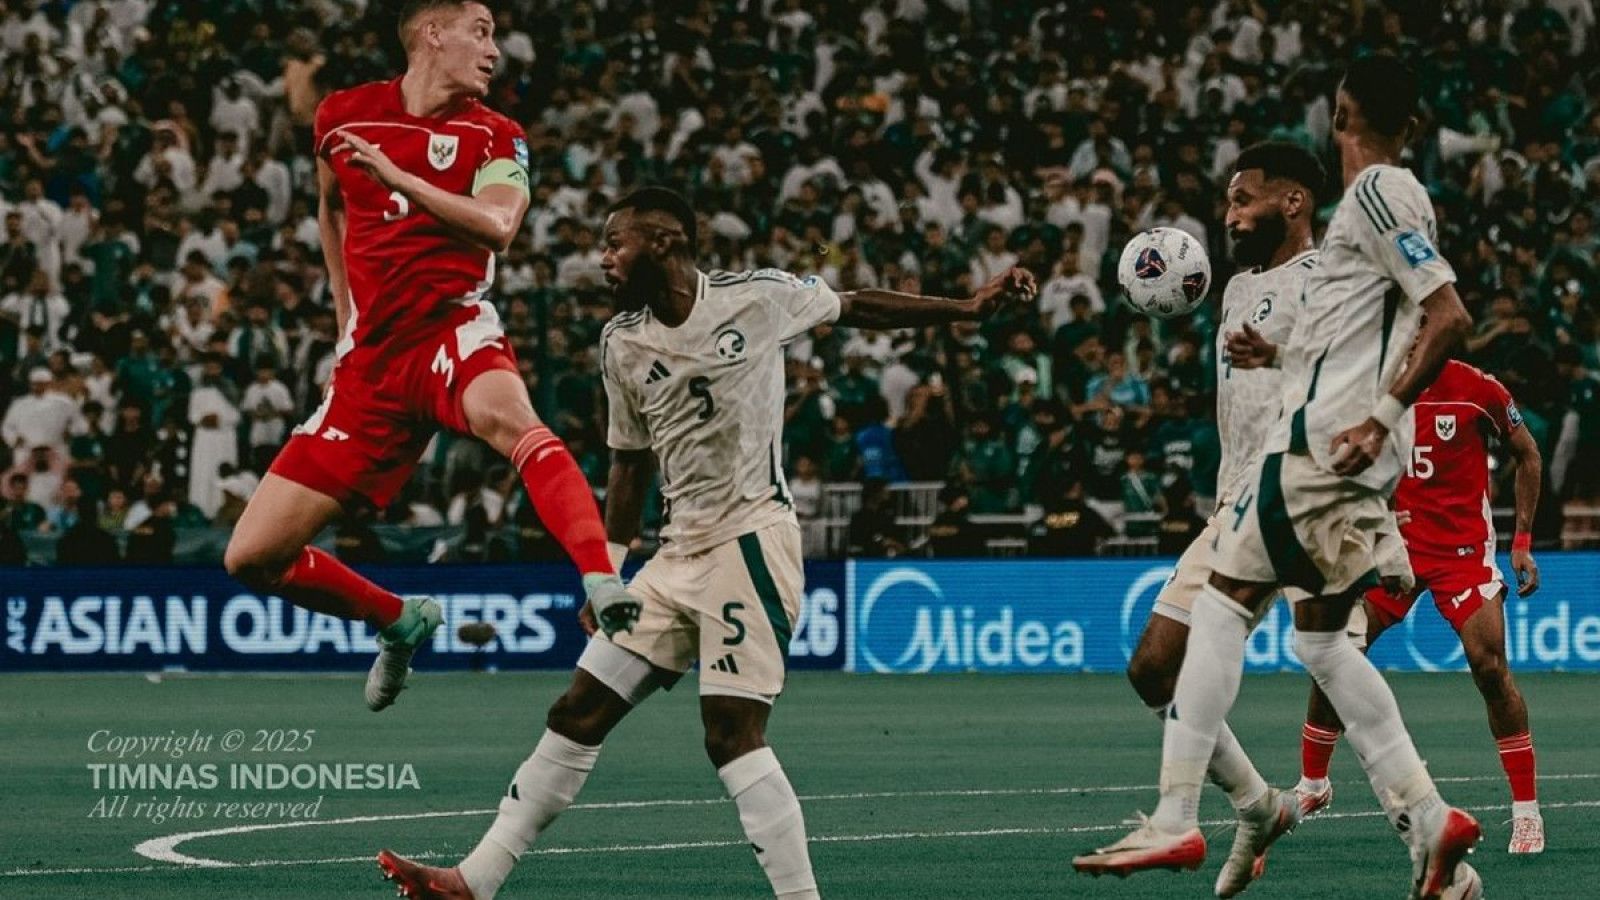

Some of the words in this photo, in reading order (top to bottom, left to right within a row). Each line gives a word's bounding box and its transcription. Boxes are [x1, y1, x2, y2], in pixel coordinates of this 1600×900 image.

[1407, 445, 1434, 480] 15
[1232, 483, 1253, 532] 4
[8, 597, 26, 653] AFC
[31, 596, 208, 654] ASIAN
[723, 602, 746, 646] 5
[890, 603, 1084, 672] Midea
